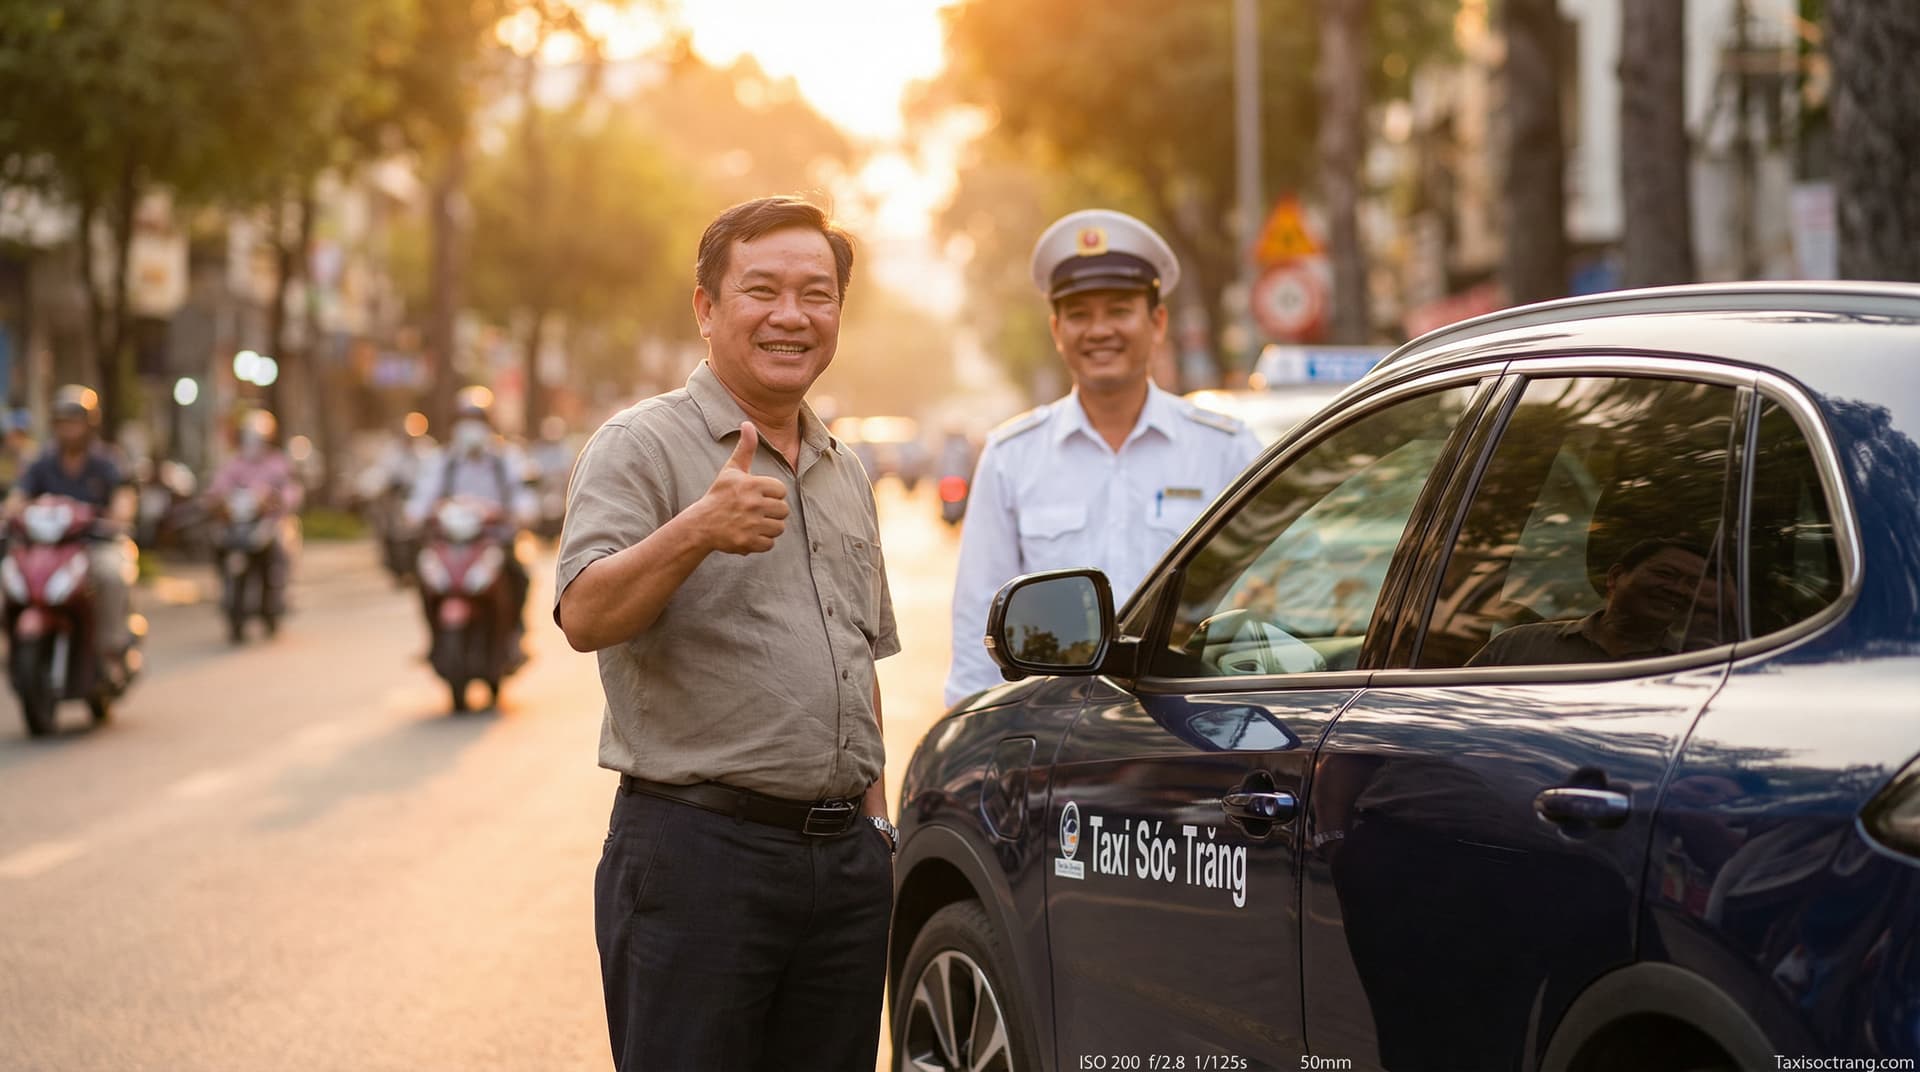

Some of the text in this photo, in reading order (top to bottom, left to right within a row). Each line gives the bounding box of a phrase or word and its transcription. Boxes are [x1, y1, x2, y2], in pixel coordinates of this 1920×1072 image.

[1089, 815, 1247, 908] Taxi Sóc Trăng
